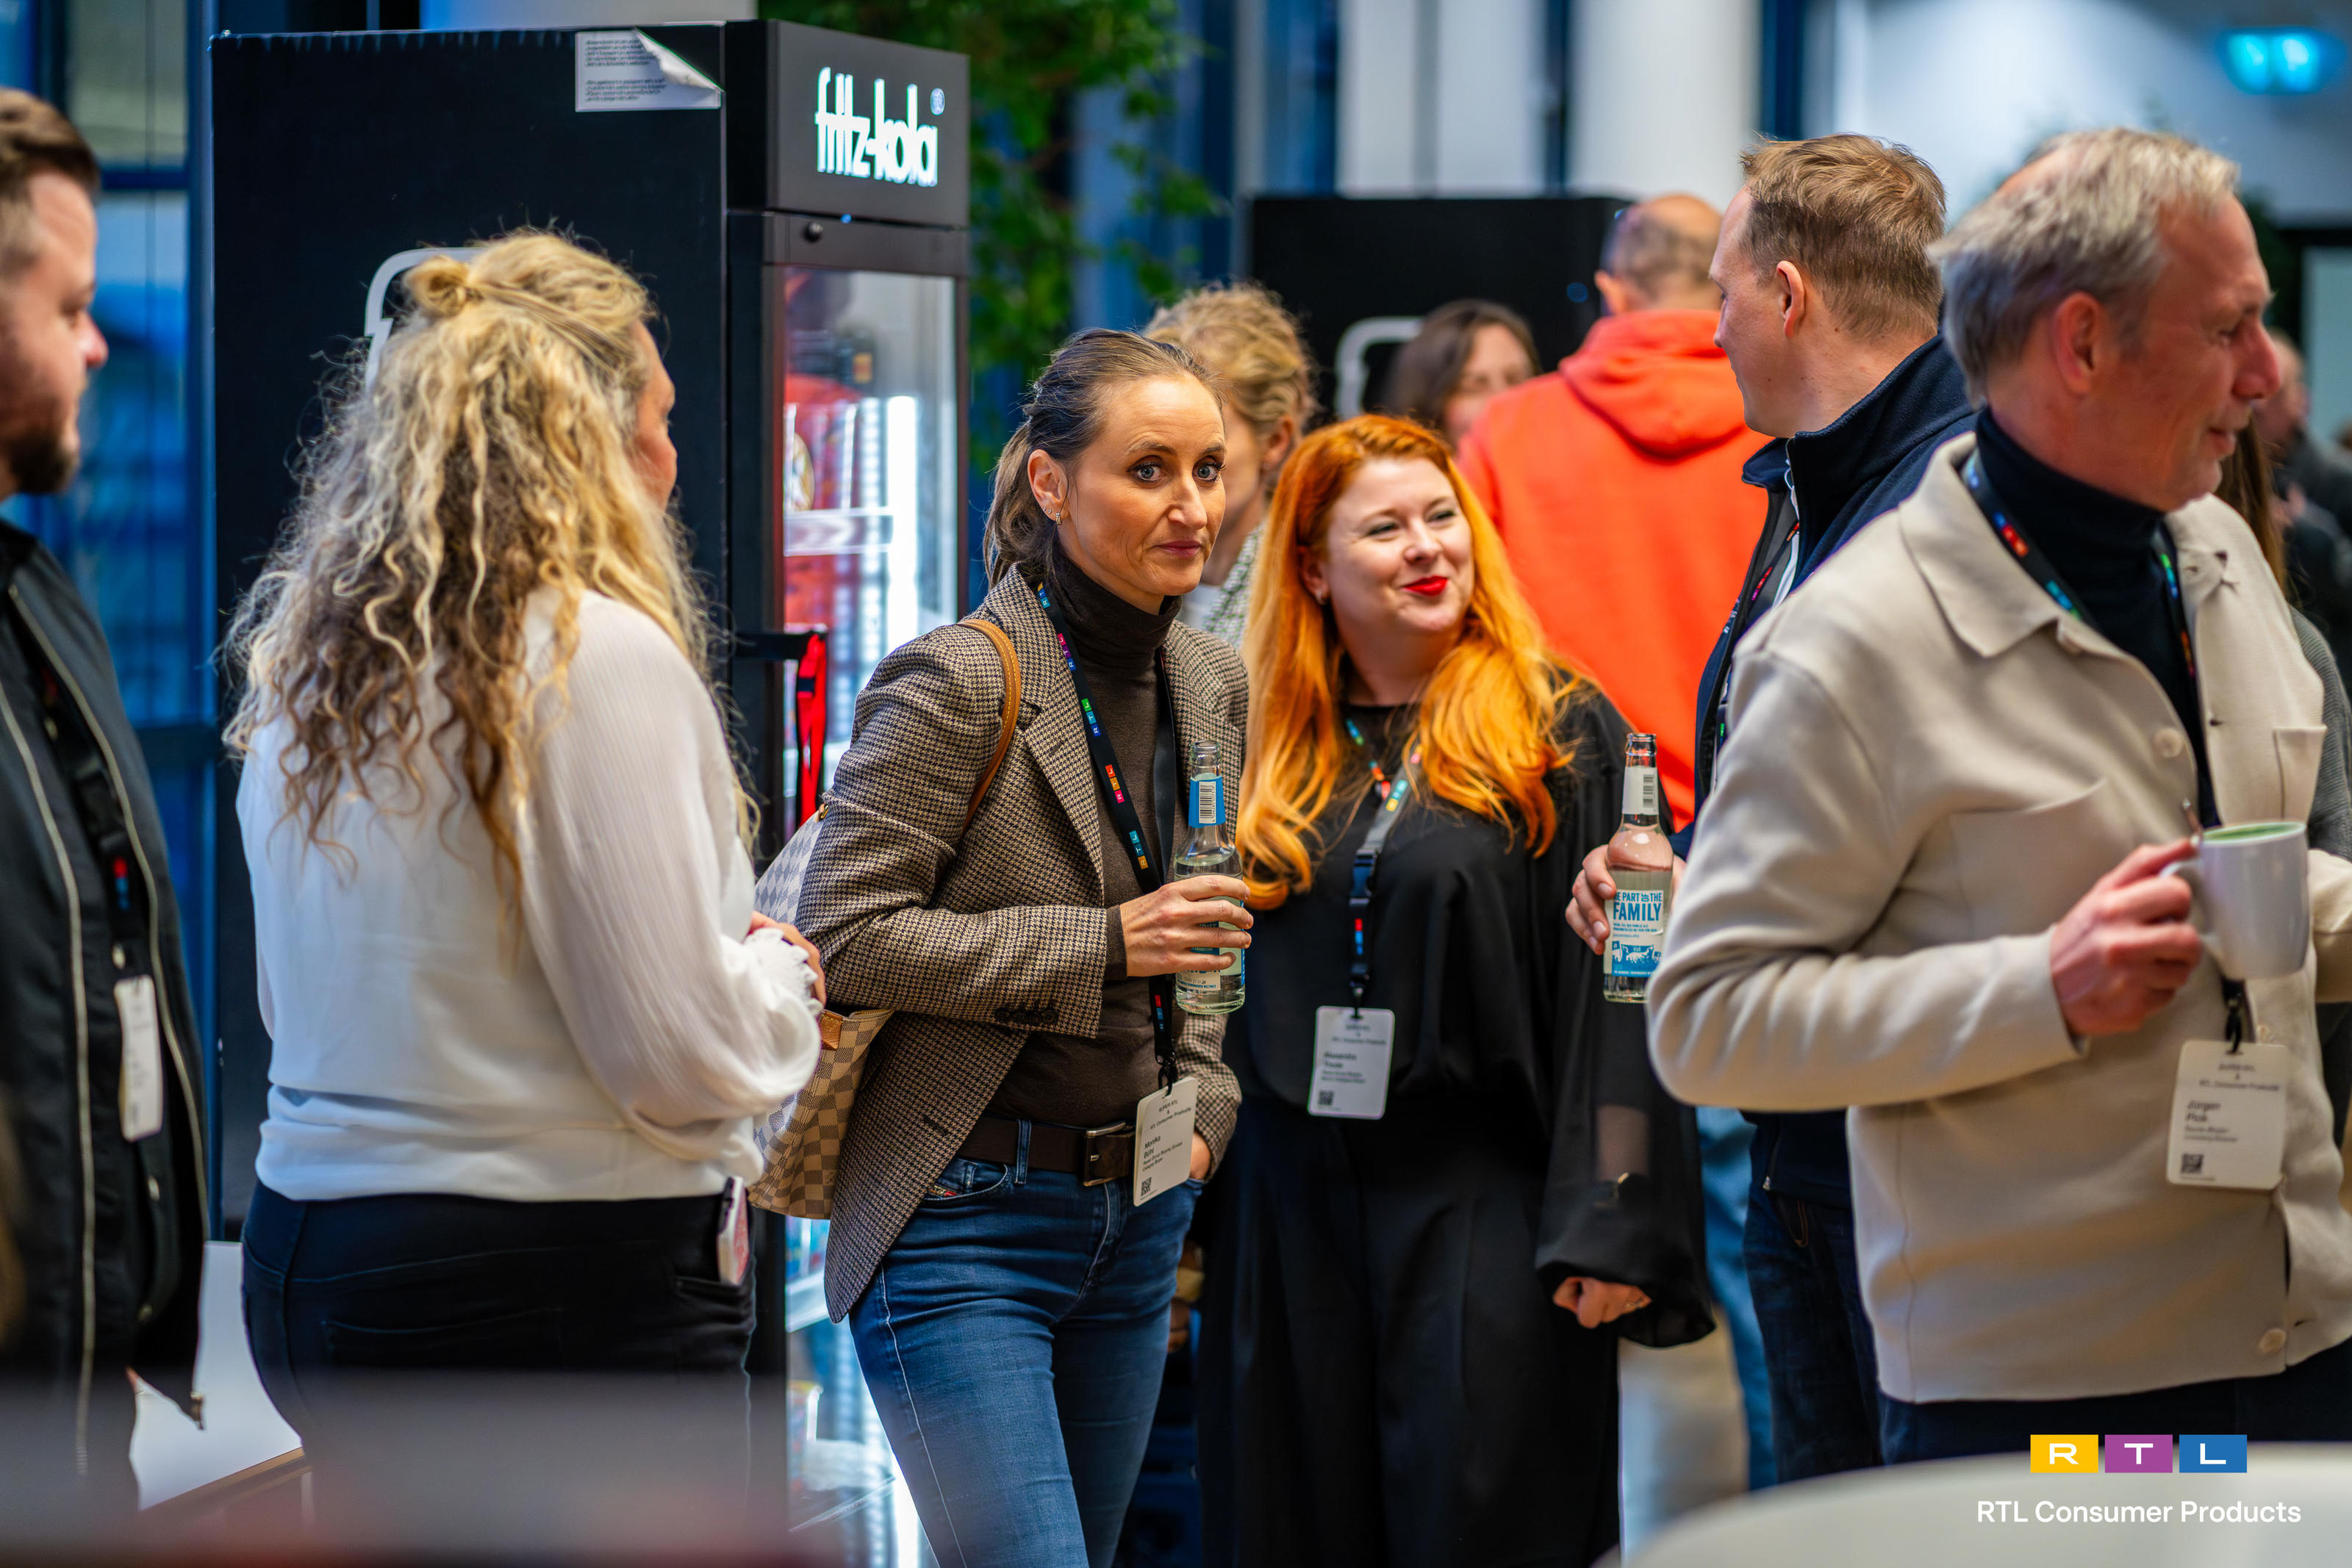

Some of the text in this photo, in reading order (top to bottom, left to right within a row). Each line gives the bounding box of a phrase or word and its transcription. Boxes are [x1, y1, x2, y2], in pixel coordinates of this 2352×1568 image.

[814, 66, 939, 187] fritz-kola
[1083, 700, 1099, 735] RTL
[1107, 766, 1123, 801] RTL
[1130, 832, 1147, 867] RTL
[1613, 902, 1661, 921] FAMILY
[1622, 892, 1640, 902] PART
[1641, 893, 1649, 902] OF
[1650, 893, 1662, 902] THE
